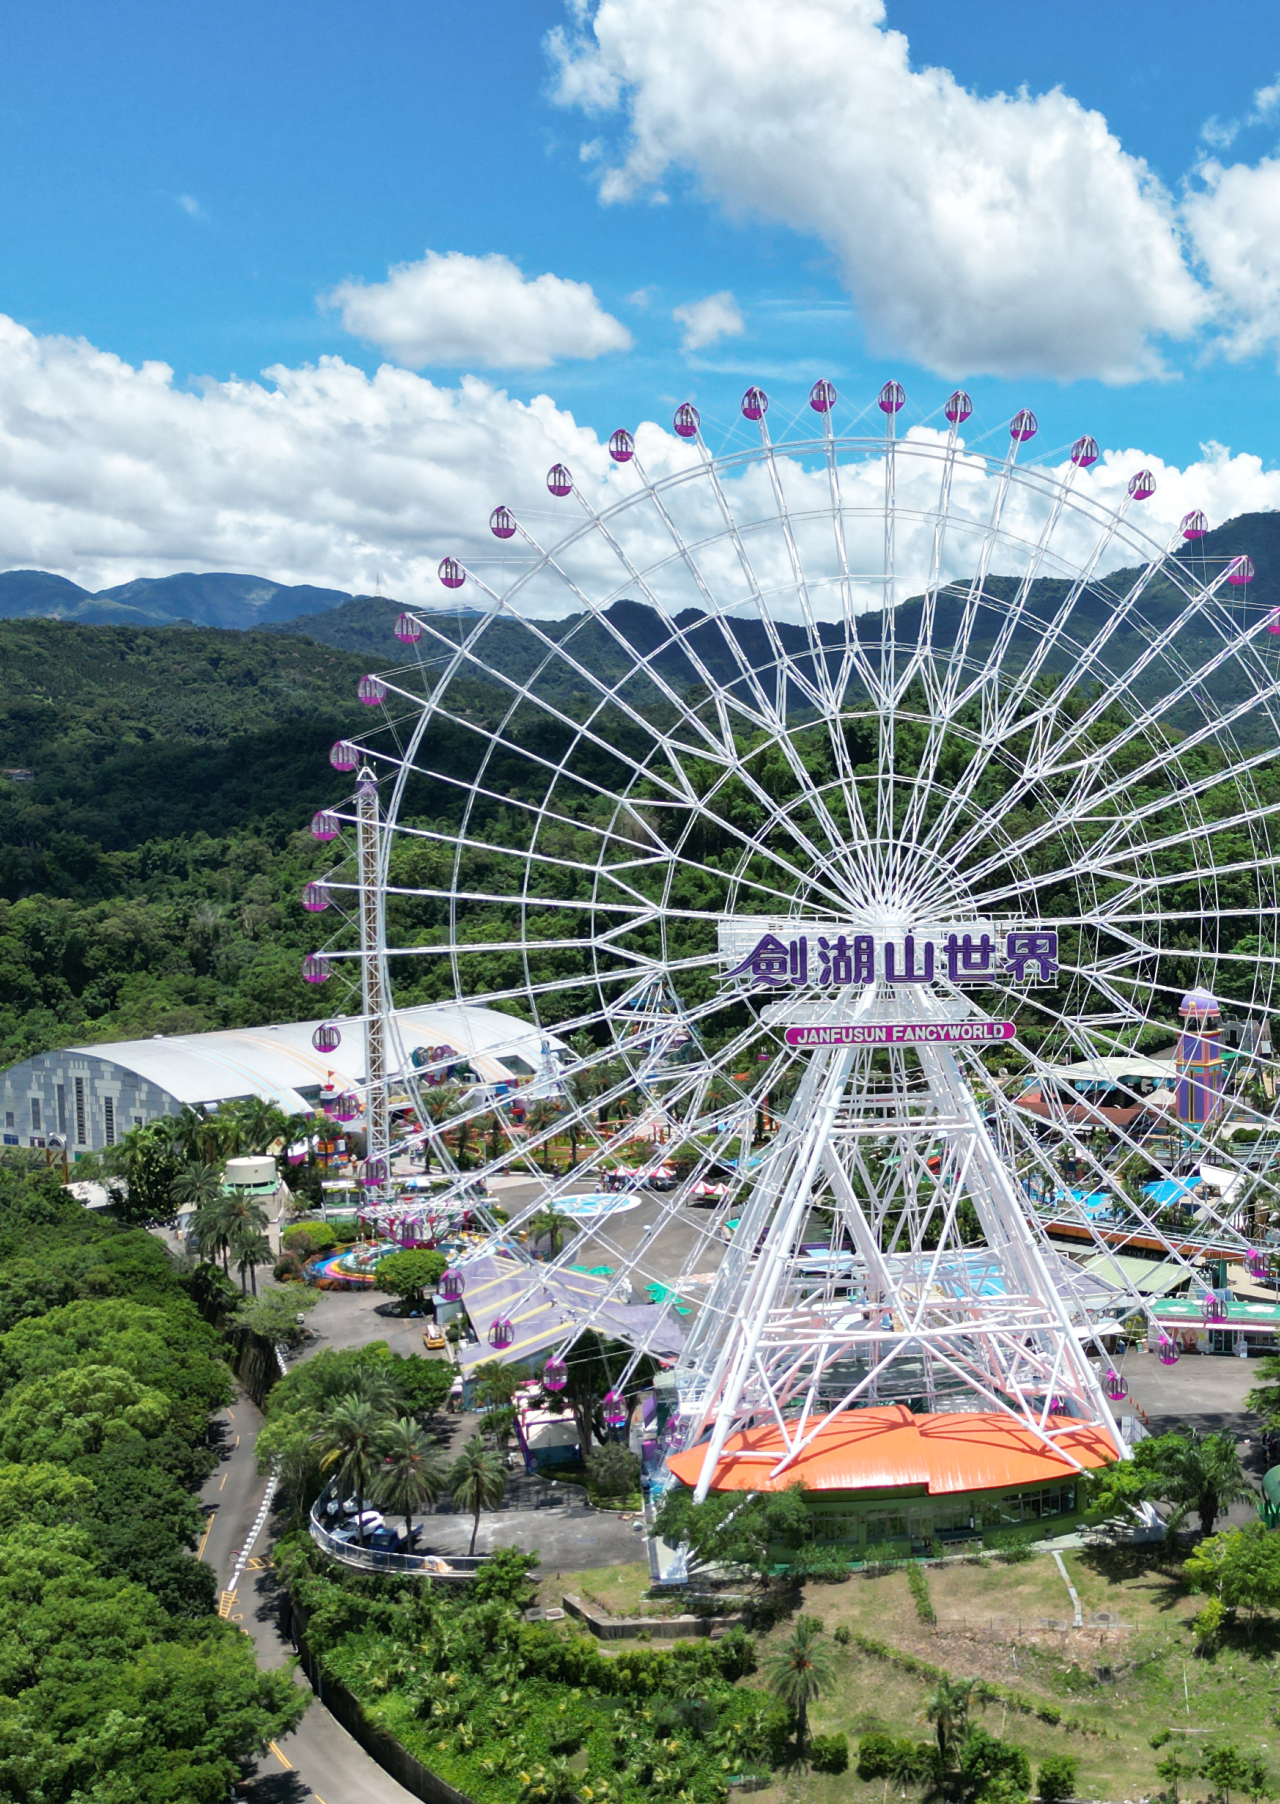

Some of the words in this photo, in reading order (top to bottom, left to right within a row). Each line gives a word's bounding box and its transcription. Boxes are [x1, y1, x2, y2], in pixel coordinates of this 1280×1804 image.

[710, 931, 1059, 985] 劍湖山世界
[797, 1027, 887, 1044] JANFUSUN
[892, 1024, 1005, 1041] FANCYWORLD
